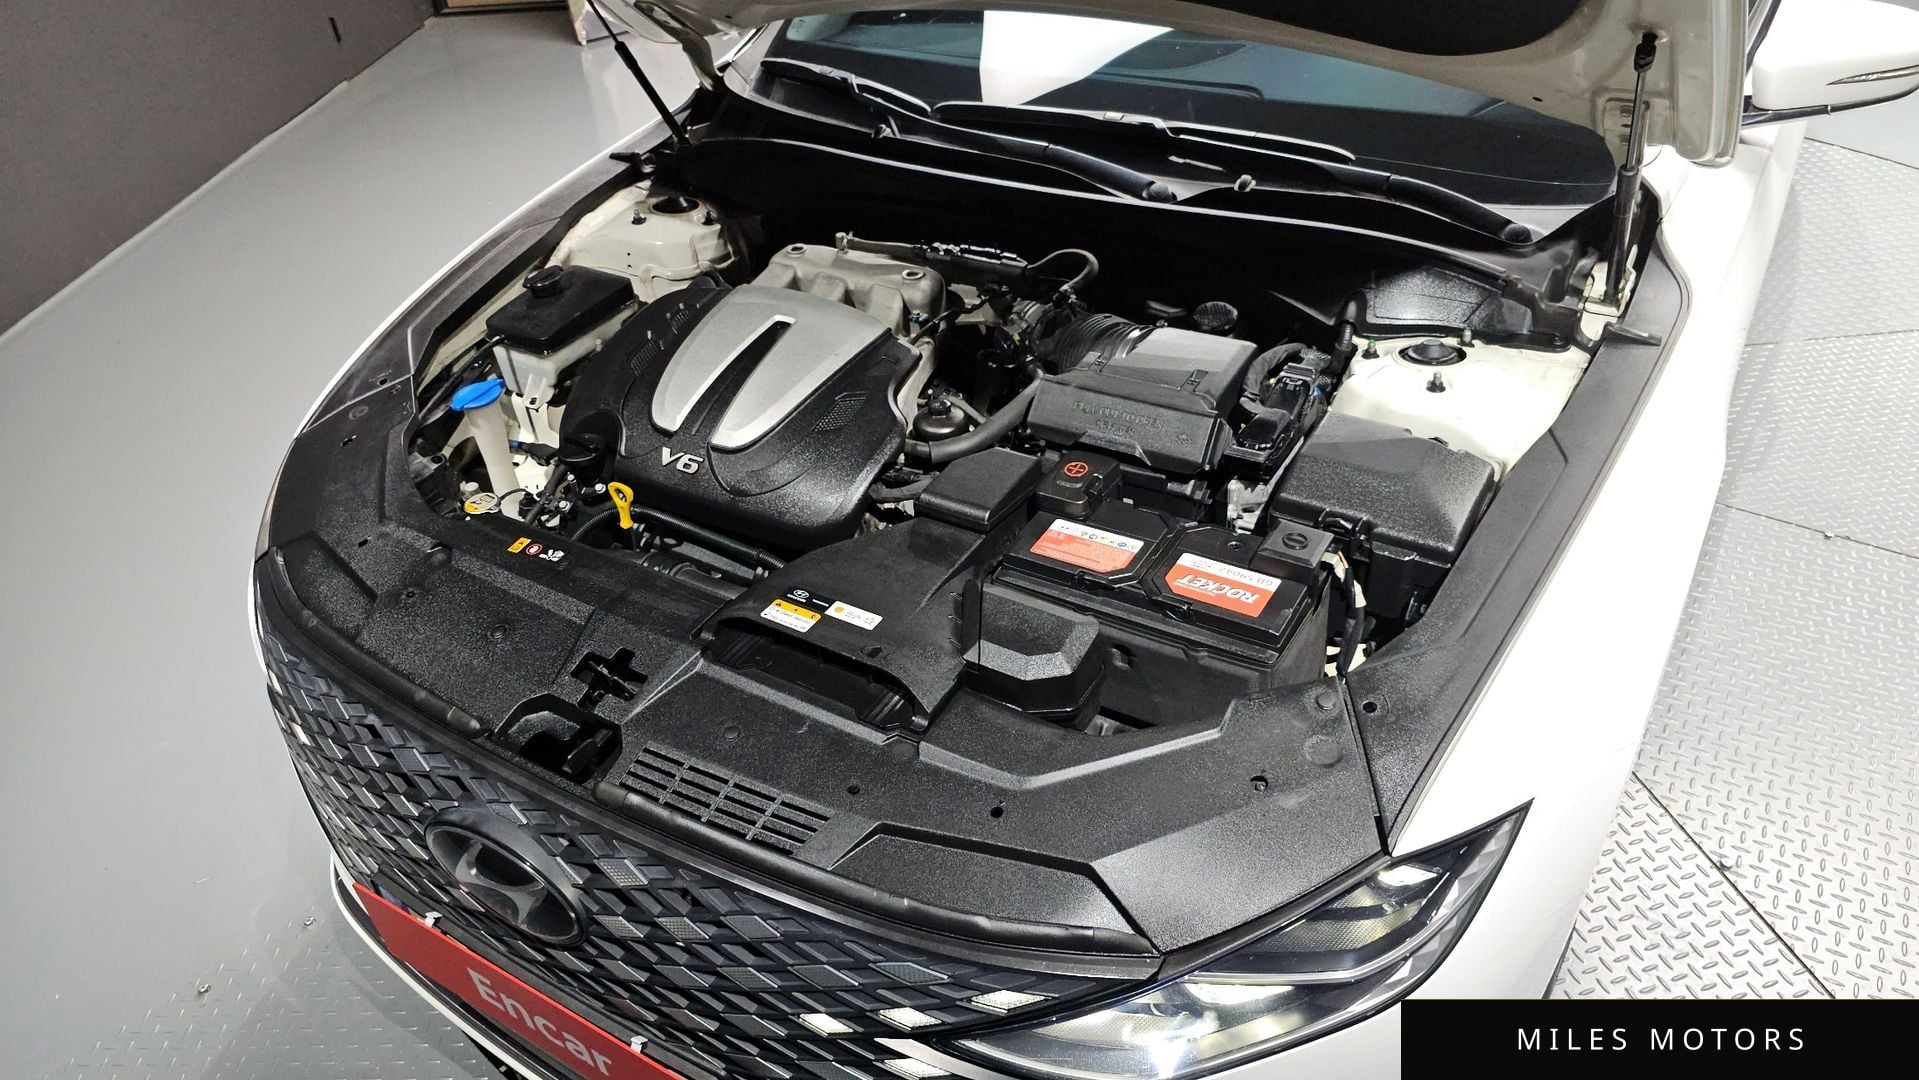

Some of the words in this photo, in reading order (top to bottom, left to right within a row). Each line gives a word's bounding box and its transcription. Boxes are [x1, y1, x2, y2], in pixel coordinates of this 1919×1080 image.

[662, 446, 704, 474] V6
[1174, 573, 1260, 605] ROCKET
[467, 967, 612, 1077] Encar
